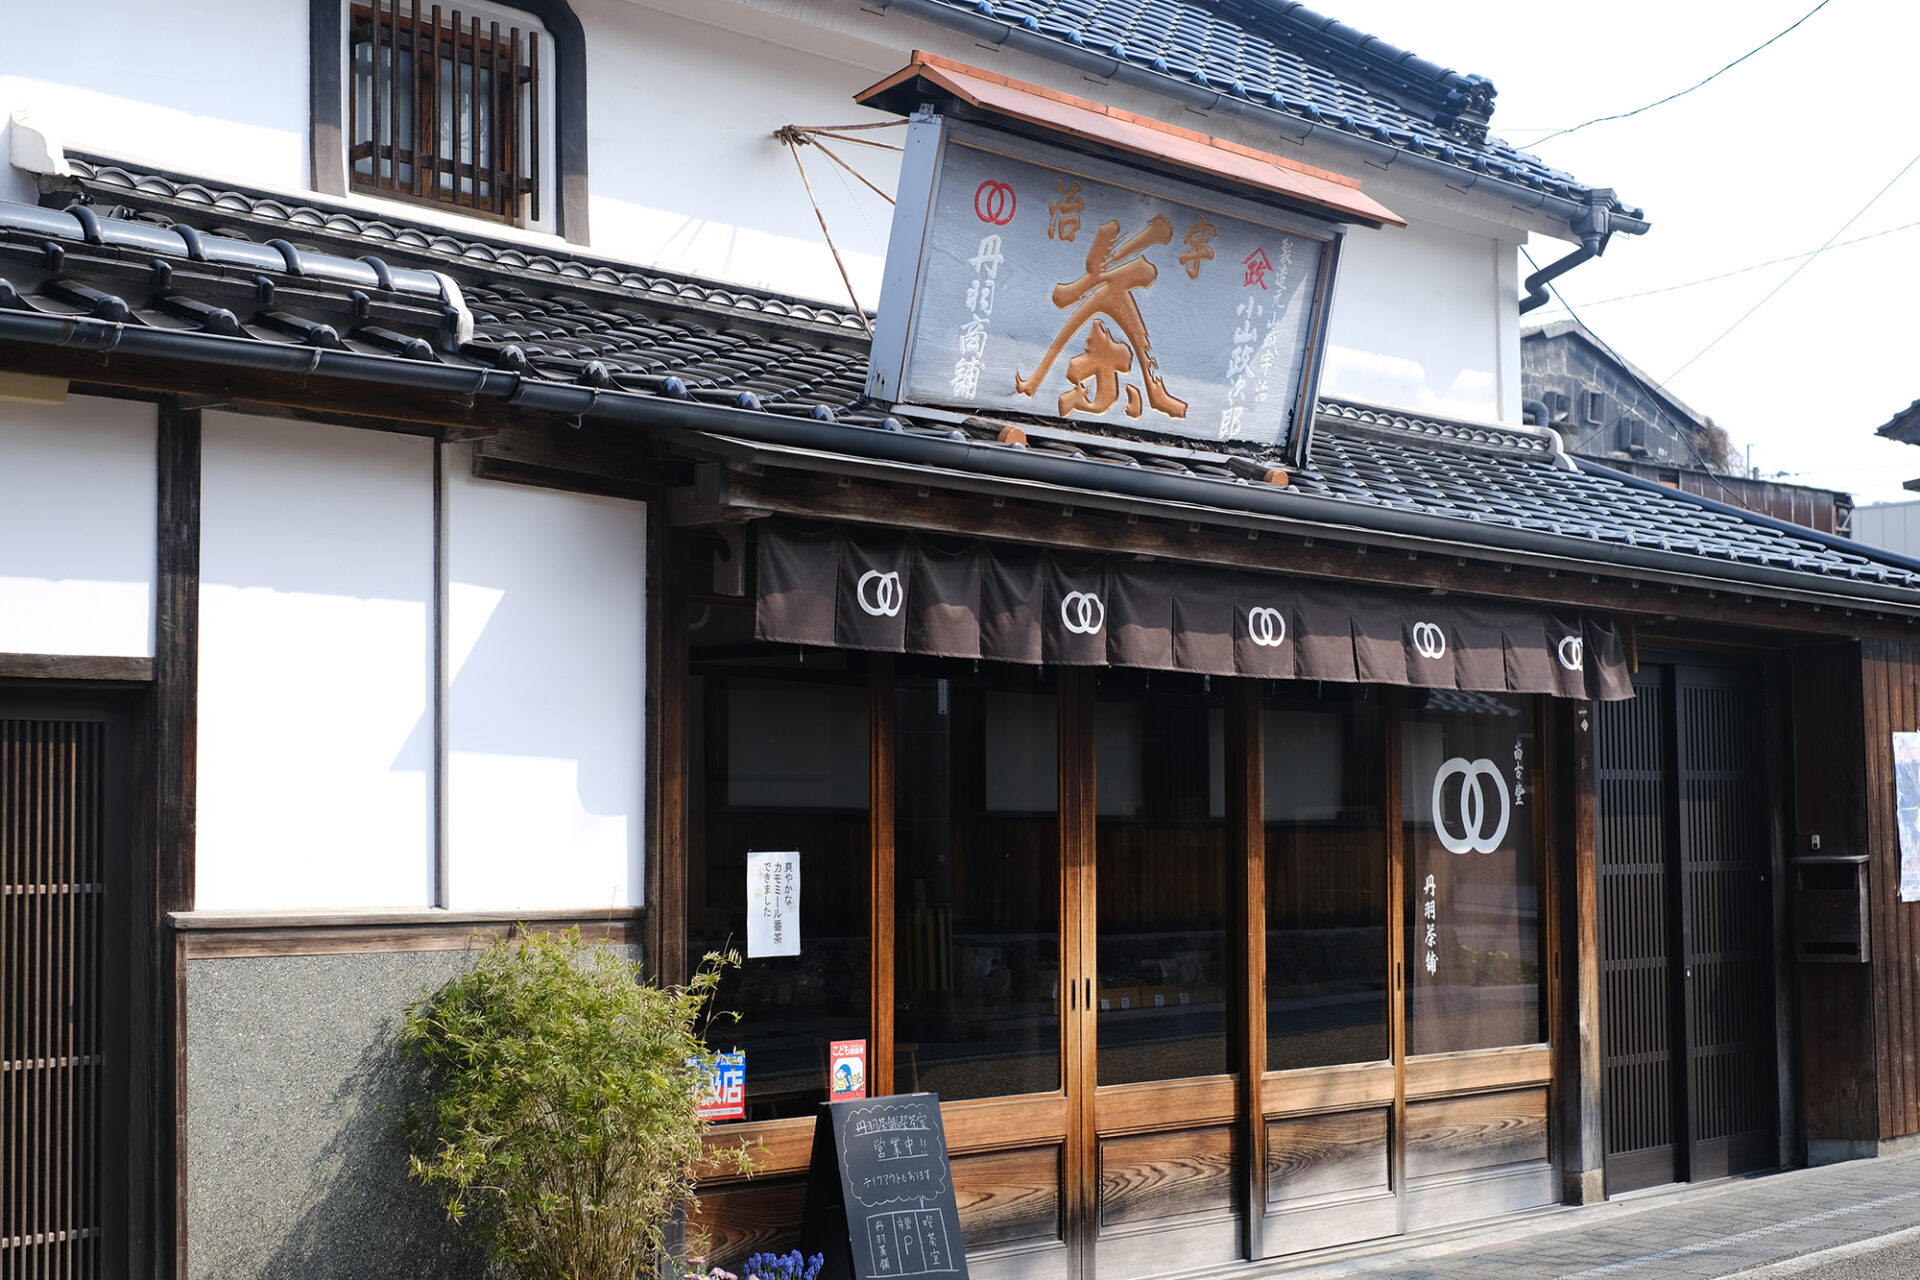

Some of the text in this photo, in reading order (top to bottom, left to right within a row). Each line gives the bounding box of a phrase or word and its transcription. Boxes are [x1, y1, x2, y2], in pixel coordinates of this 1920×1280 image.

[1048, 177, 1217, 280] 宇 治
[1015, 213, 1188, 420] 茶
[763, 862, 771, 918] できました
[773, 862, 782, 945] カモミール番茶
[784, 862, 793, 906] 爽やかな
